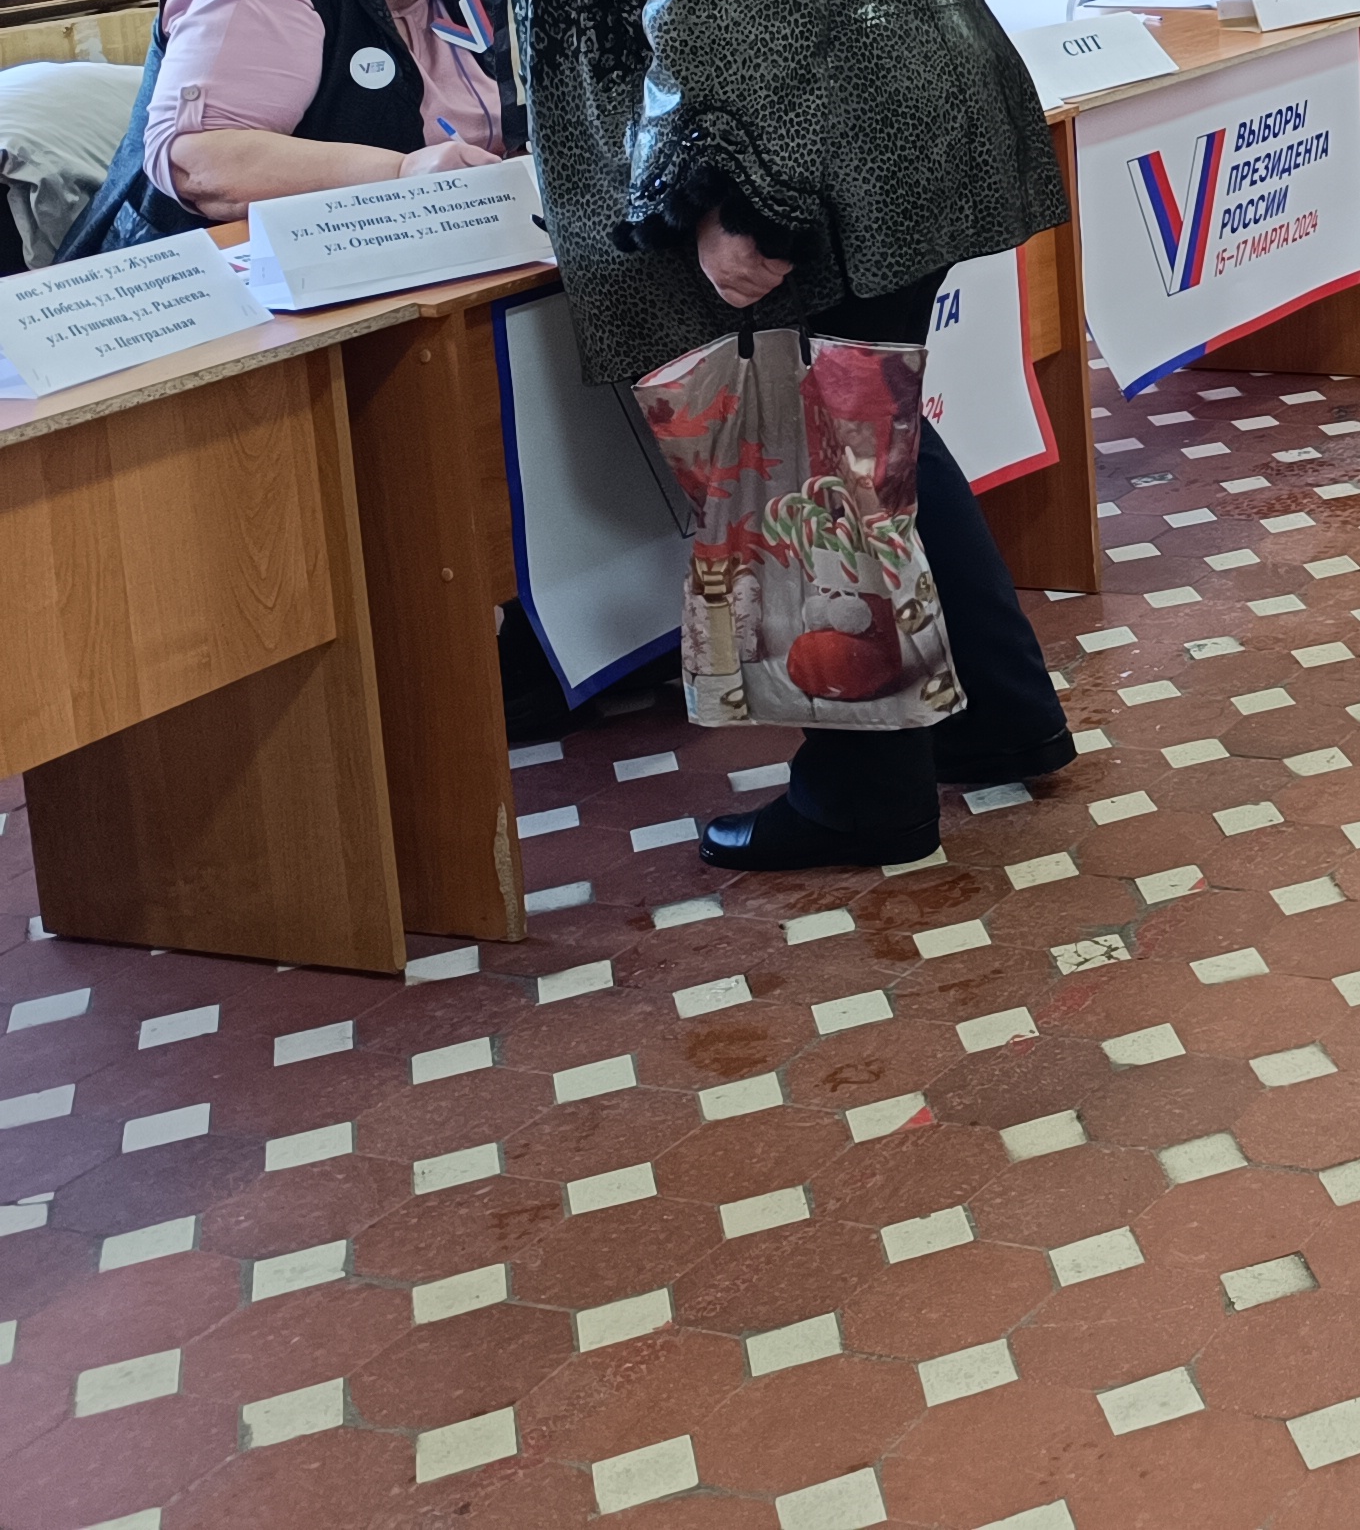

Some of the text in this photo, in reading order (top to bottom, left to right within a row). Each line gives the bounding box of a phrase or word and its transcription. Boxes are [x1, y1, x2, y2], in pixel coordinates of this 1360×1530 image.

[1233, 99, 1308, 153] ВЫБОРЫ
[1226, 130, 1330, 197] ПРЕЗИДЕНТА
[290, 191, 517, 241] ул. Мичурина, ул. Молодежная,
[325, 177, 469, 213] ул. Лесная, ул. ЛЗС,
[1218, 184, 1289, 240] РОССИИ
[323, 212, 501, 256] ул. Озерная, ул. Полевая
[1248, 226, 1290, 263] МАРТА
[1291, 208, 1319, 245] 2024
[14, 248, 182, 303] пос. Уютный: ул. Жукова,
[18, 265, 207, 331] ул. Победы, ул. Придорожная,
[45, 288, 212, 348] ул. Пушкина, ул. Рылеева,
[94, 316, 197, 358] ул. Центральная
